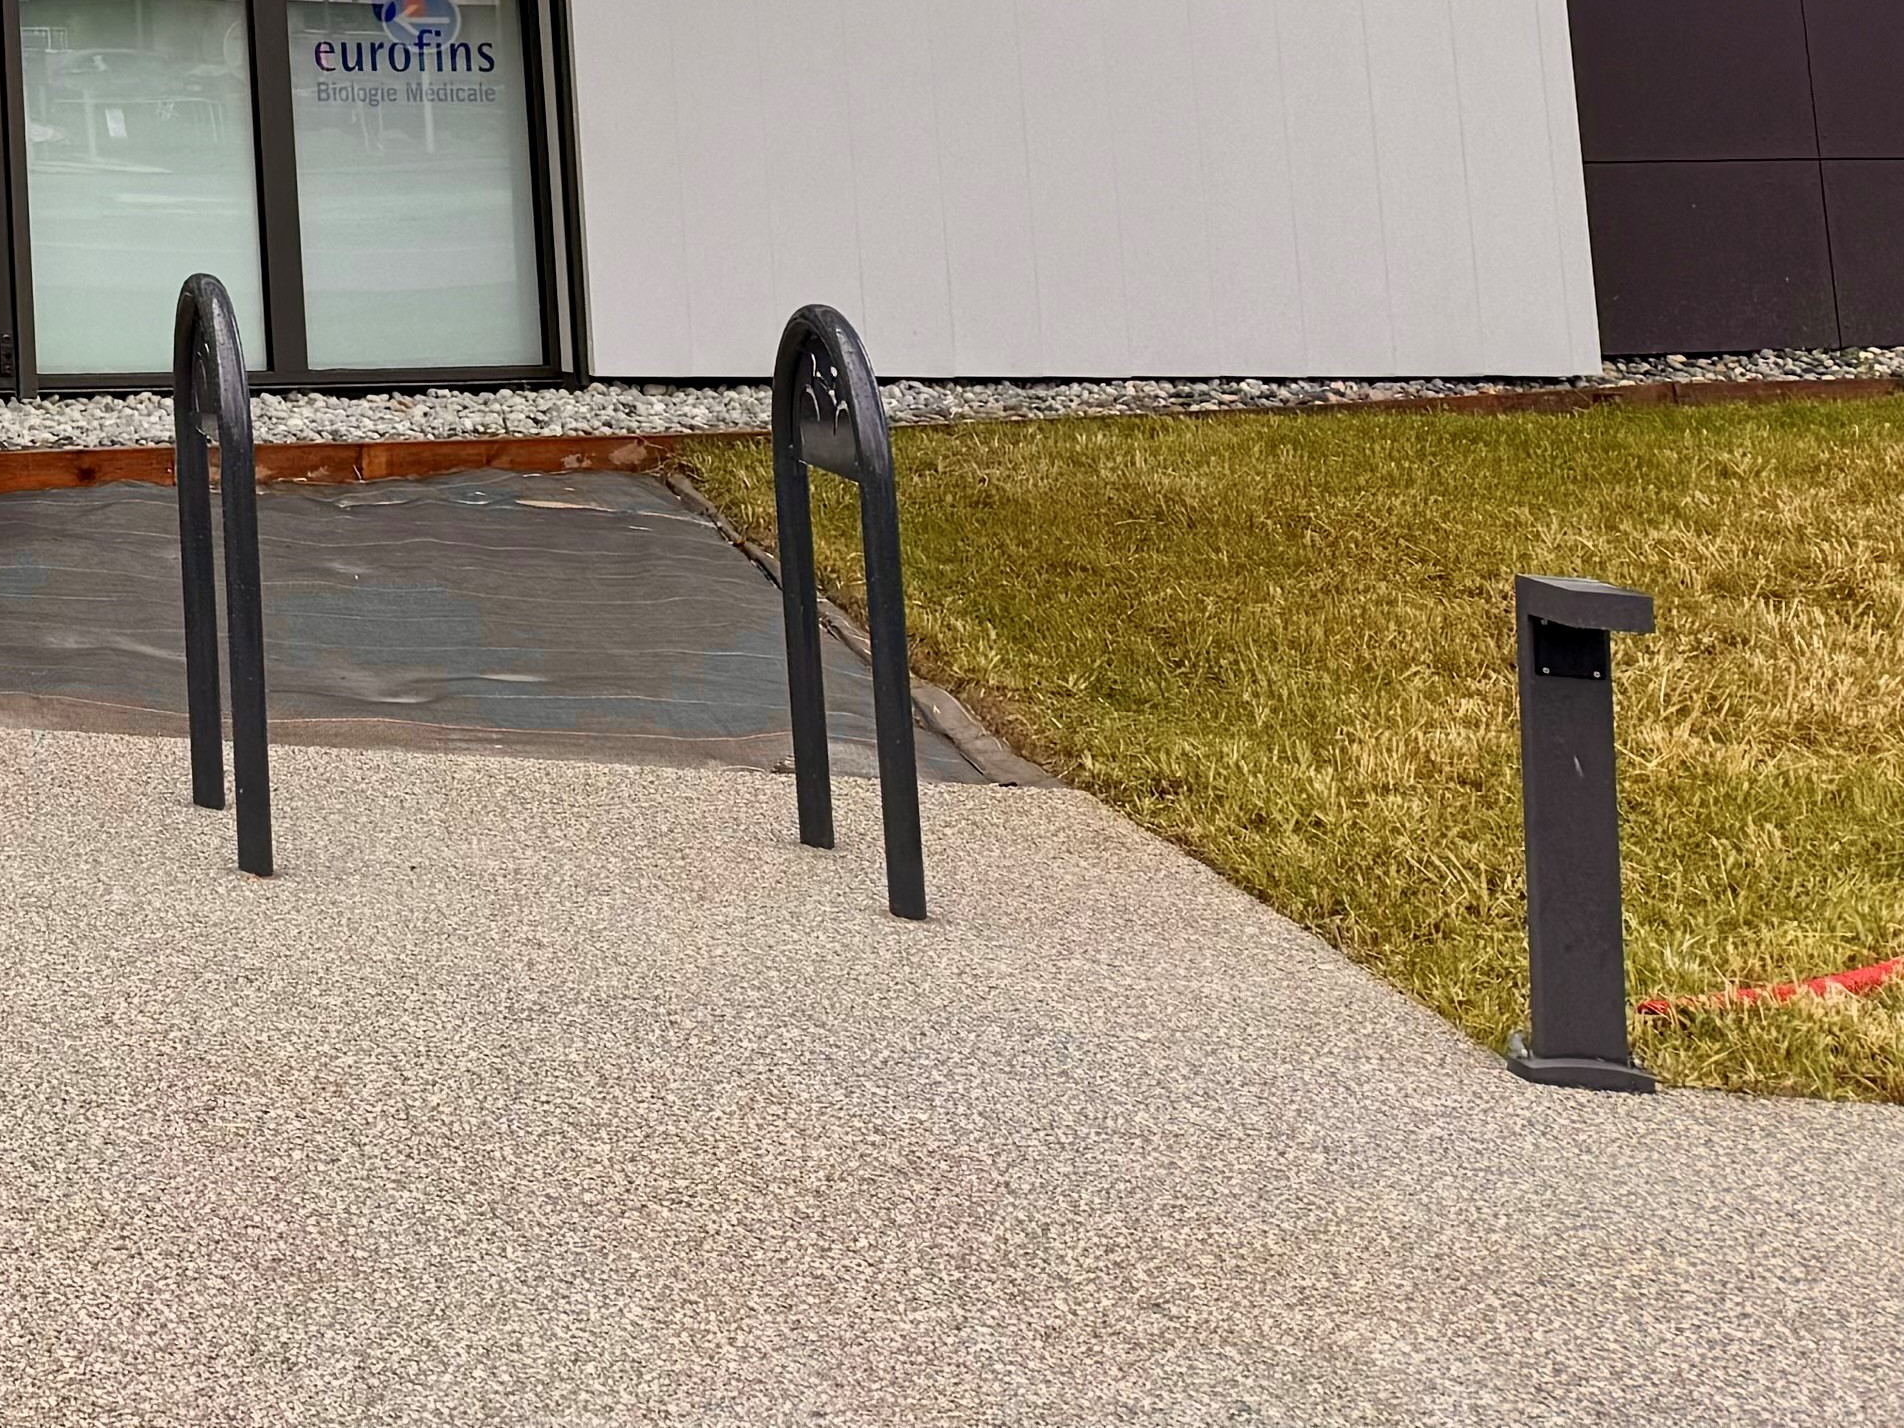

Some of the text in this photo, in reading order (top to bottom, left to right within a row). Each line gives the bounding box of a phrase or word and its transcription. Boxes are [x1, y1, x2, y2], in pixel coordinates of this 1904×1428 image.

[314, 28, 496, 73] eurofins
[317, 81, 496, 107] Biologie Médicale
